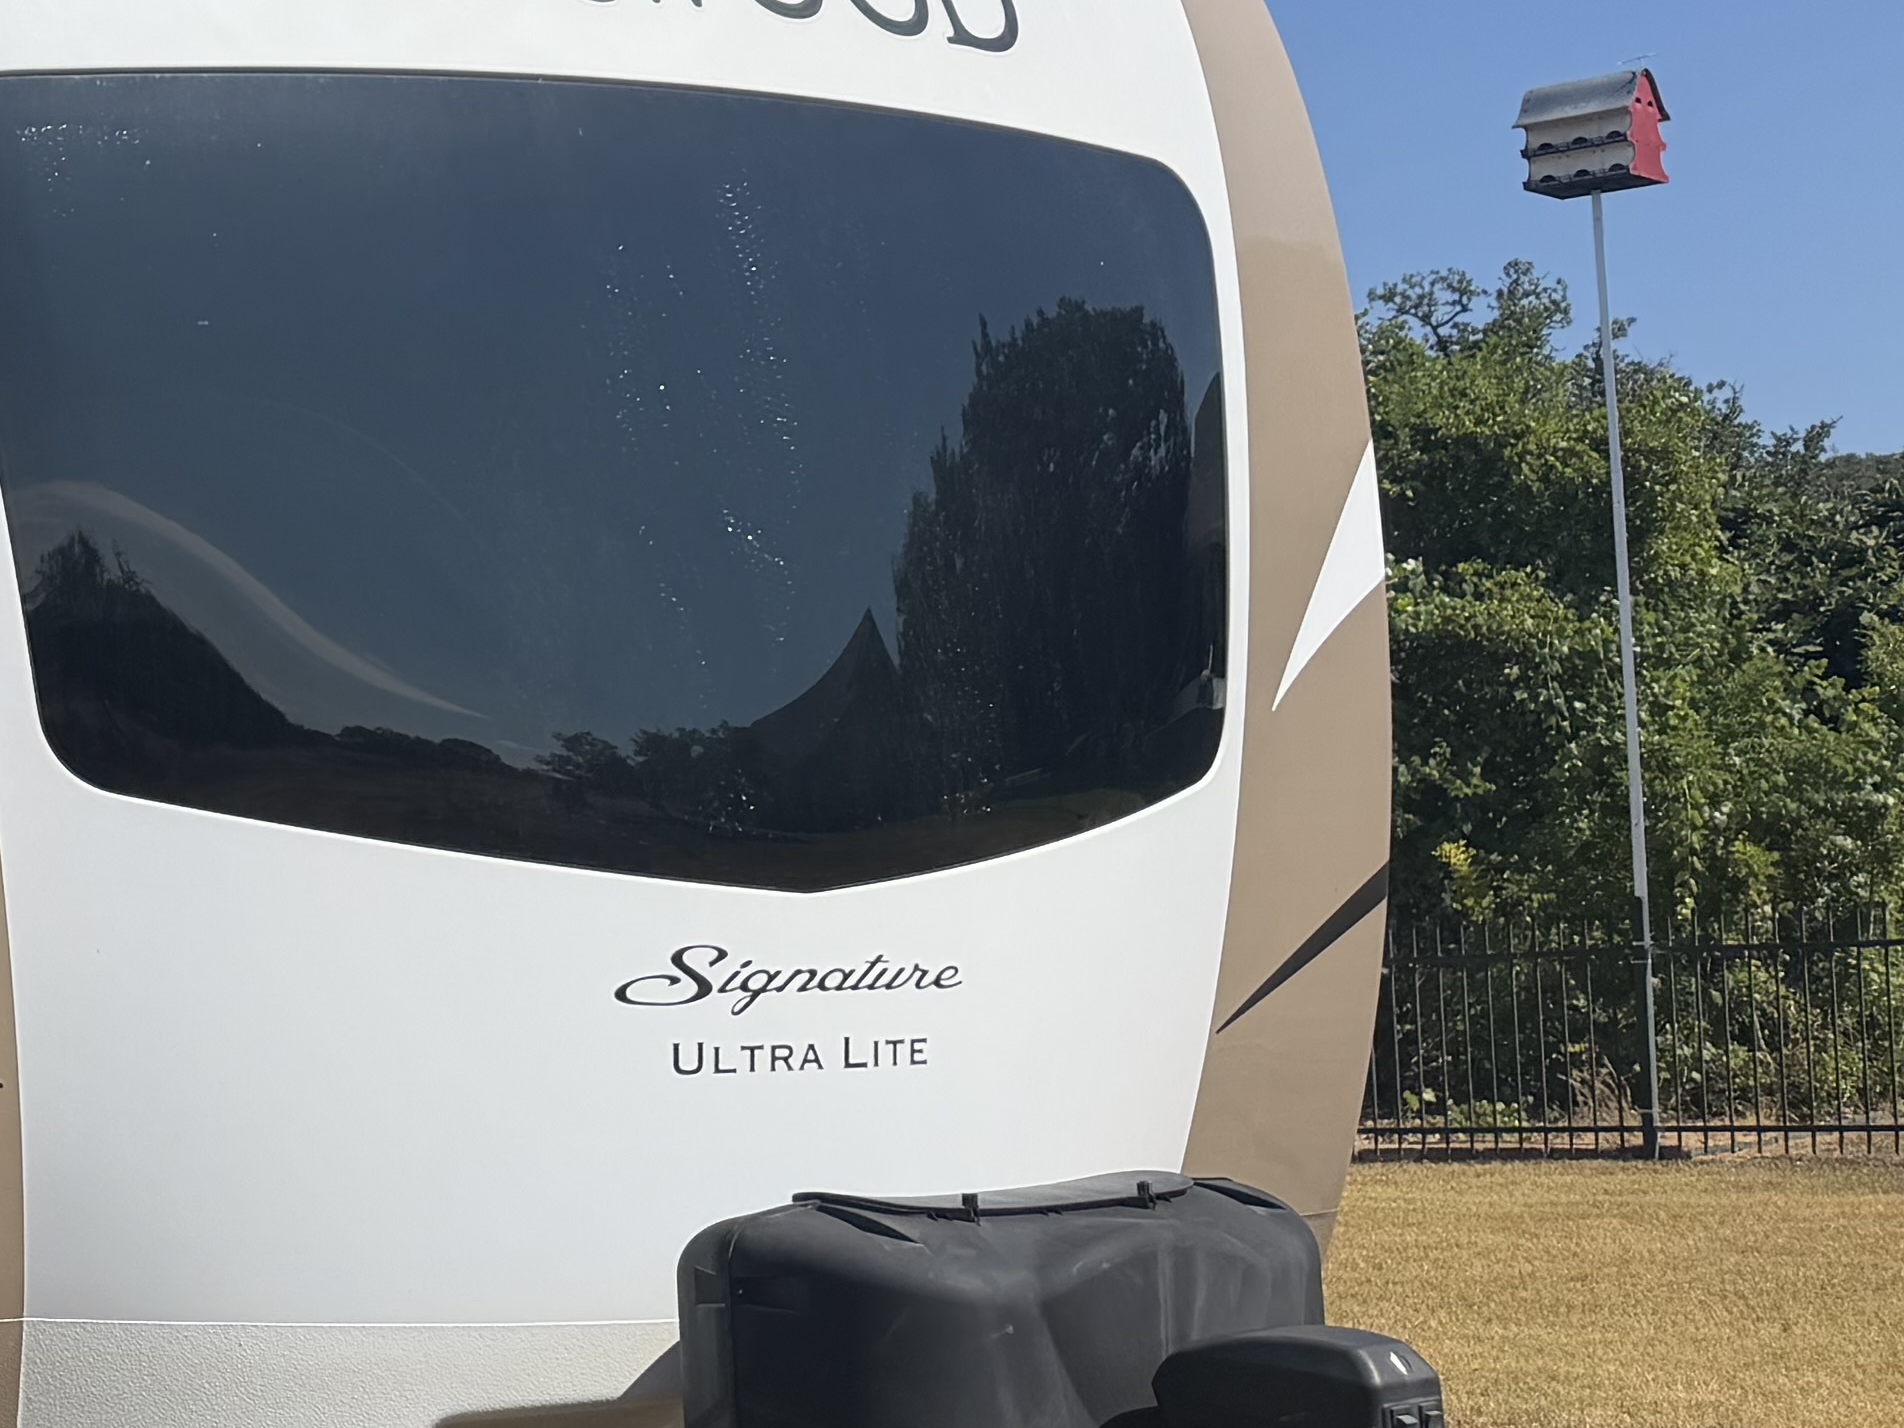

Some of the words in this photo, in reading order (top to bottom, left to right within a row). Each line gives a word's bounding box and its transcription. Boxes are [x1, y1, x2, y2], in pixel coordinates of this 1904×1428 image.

[613, 944, 963, 1017] Signature
[671, 1039, 825, 1076] ULTRA
[842, 1035, 929, 1069] LITE
